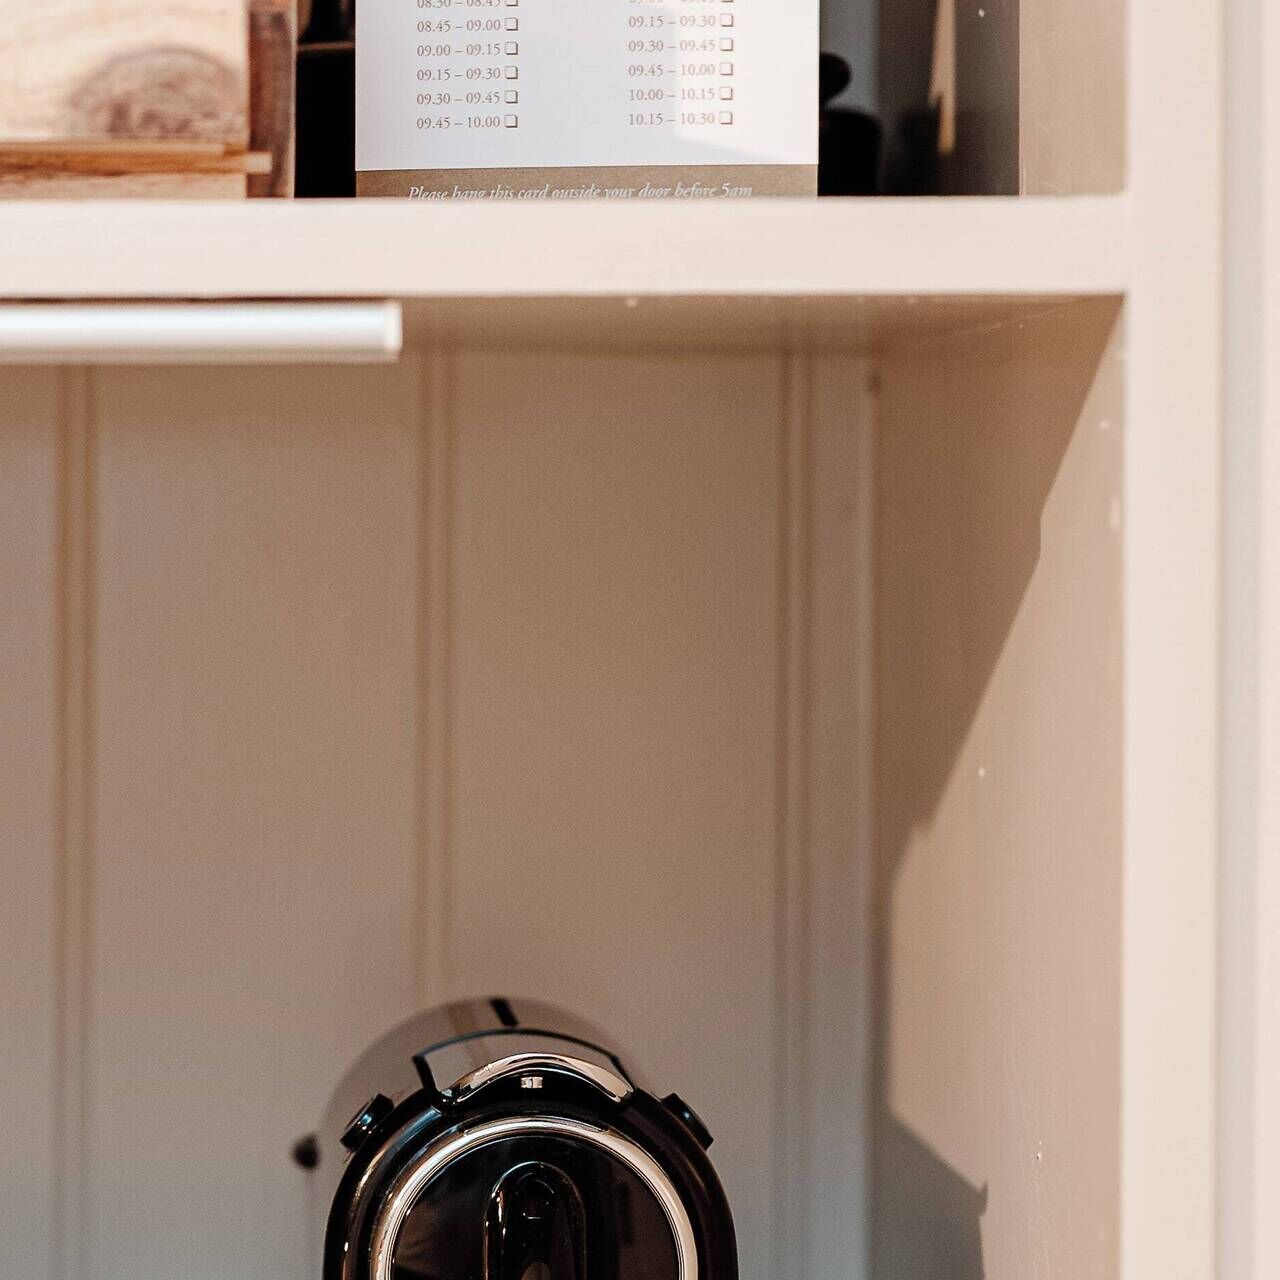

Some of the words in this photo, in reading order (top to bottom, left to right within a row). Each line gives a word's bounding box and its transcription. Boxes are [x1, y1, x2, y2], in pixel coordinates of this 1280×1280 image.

[417, 19, 451, 32] 08.45
[466, 18, 501, 31] 09.00
[629, 16, 666, 28] 09.15
[680, 15, 716, 29] 09.30
[417, 45, 451, 57] 09.00
[466, 43, 500, 56] 09.15
[628, 40, 664, 53] 09.30
[680, 39, 716, 52] 09.45
[417, 68, 450, 81] 09.15
[465, 67, 501, 80] 09.30
[628, 64, 663, 77] 09.45
[680, 64, 716, 76] 10.00
[417, 93, 450, 105] 09.30
[466, 92, 500, 104] 09.45
[630, 89, 664, 101] 10.00
[681, 88, 715, 100] 10.15
[417, 117, 450, 129] 09.45
[468, 116, 500, 128] 10.00
[630, 113, 663, 125] 10.15
[681, 113, 715, 125] 10.30
[408, 185, 448, 200] Please
[490, 184, 514, 200] this
[518, 184, 551, 200] card
[551, 184, 601, 199] outside
[638, 182, 671, 198] door
[674, 181, 718, 198] before
[721, 182, 753, 198] 5am
